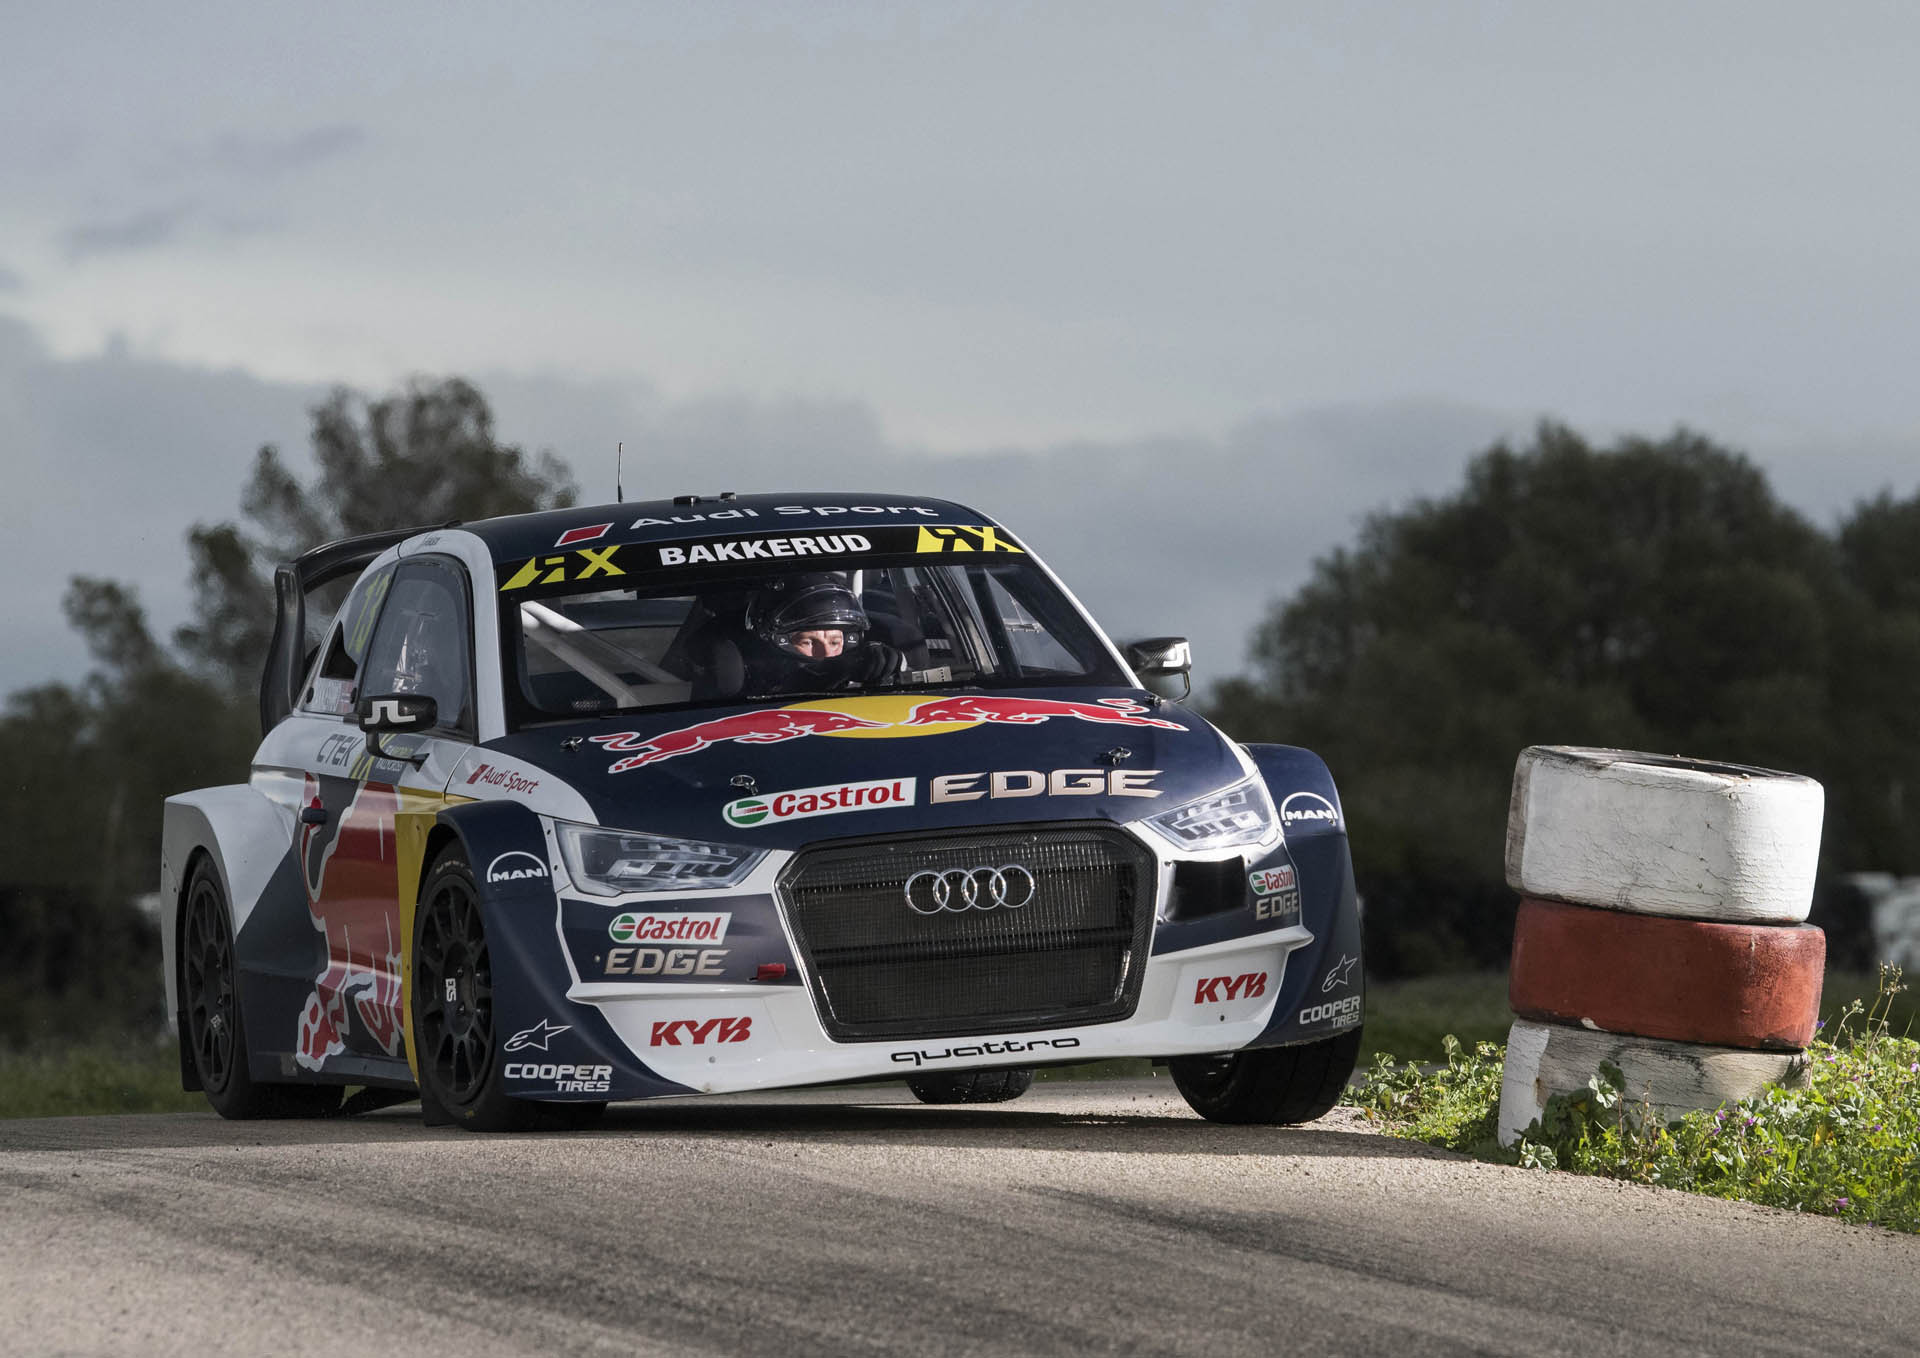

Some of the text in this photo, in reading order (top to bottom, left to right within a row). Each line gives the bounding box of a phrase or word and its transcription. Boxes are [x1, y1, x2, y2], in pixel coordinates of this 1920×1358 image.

[630, 505, 939, 529] Audi Sport
[659, 534, 872, 566] BAKKERUD
[316, 734, 363, 767] CTEK
[480, 766, 539, 794] Audi Sport
[930, 769, 1163, 804] EDGE
[772, 779, 906, 818] Castrol
[1286, 810, 1331, 820] MAN
[492, 867, 543, 882] MAN
[1265, 867, 1294, 891] Castrol
[1256, 892, 1299, 920] EDGE
[635, 915, 719, 941] Castrol
[604, 948, 731, 976] EDGE
[1194, 972, 1267, 1004] KYB
[1300, 996, 1360, 1024] COOPER
[1331, 1011, 1359, 1028] TIRES
[650, 1017, 752, 1046] KYB
[891, 1038, 1080, 1065] quattro
[504, 1064, 612, 1080] COOPER
[555, 1080, 610, 1092] TIRES
